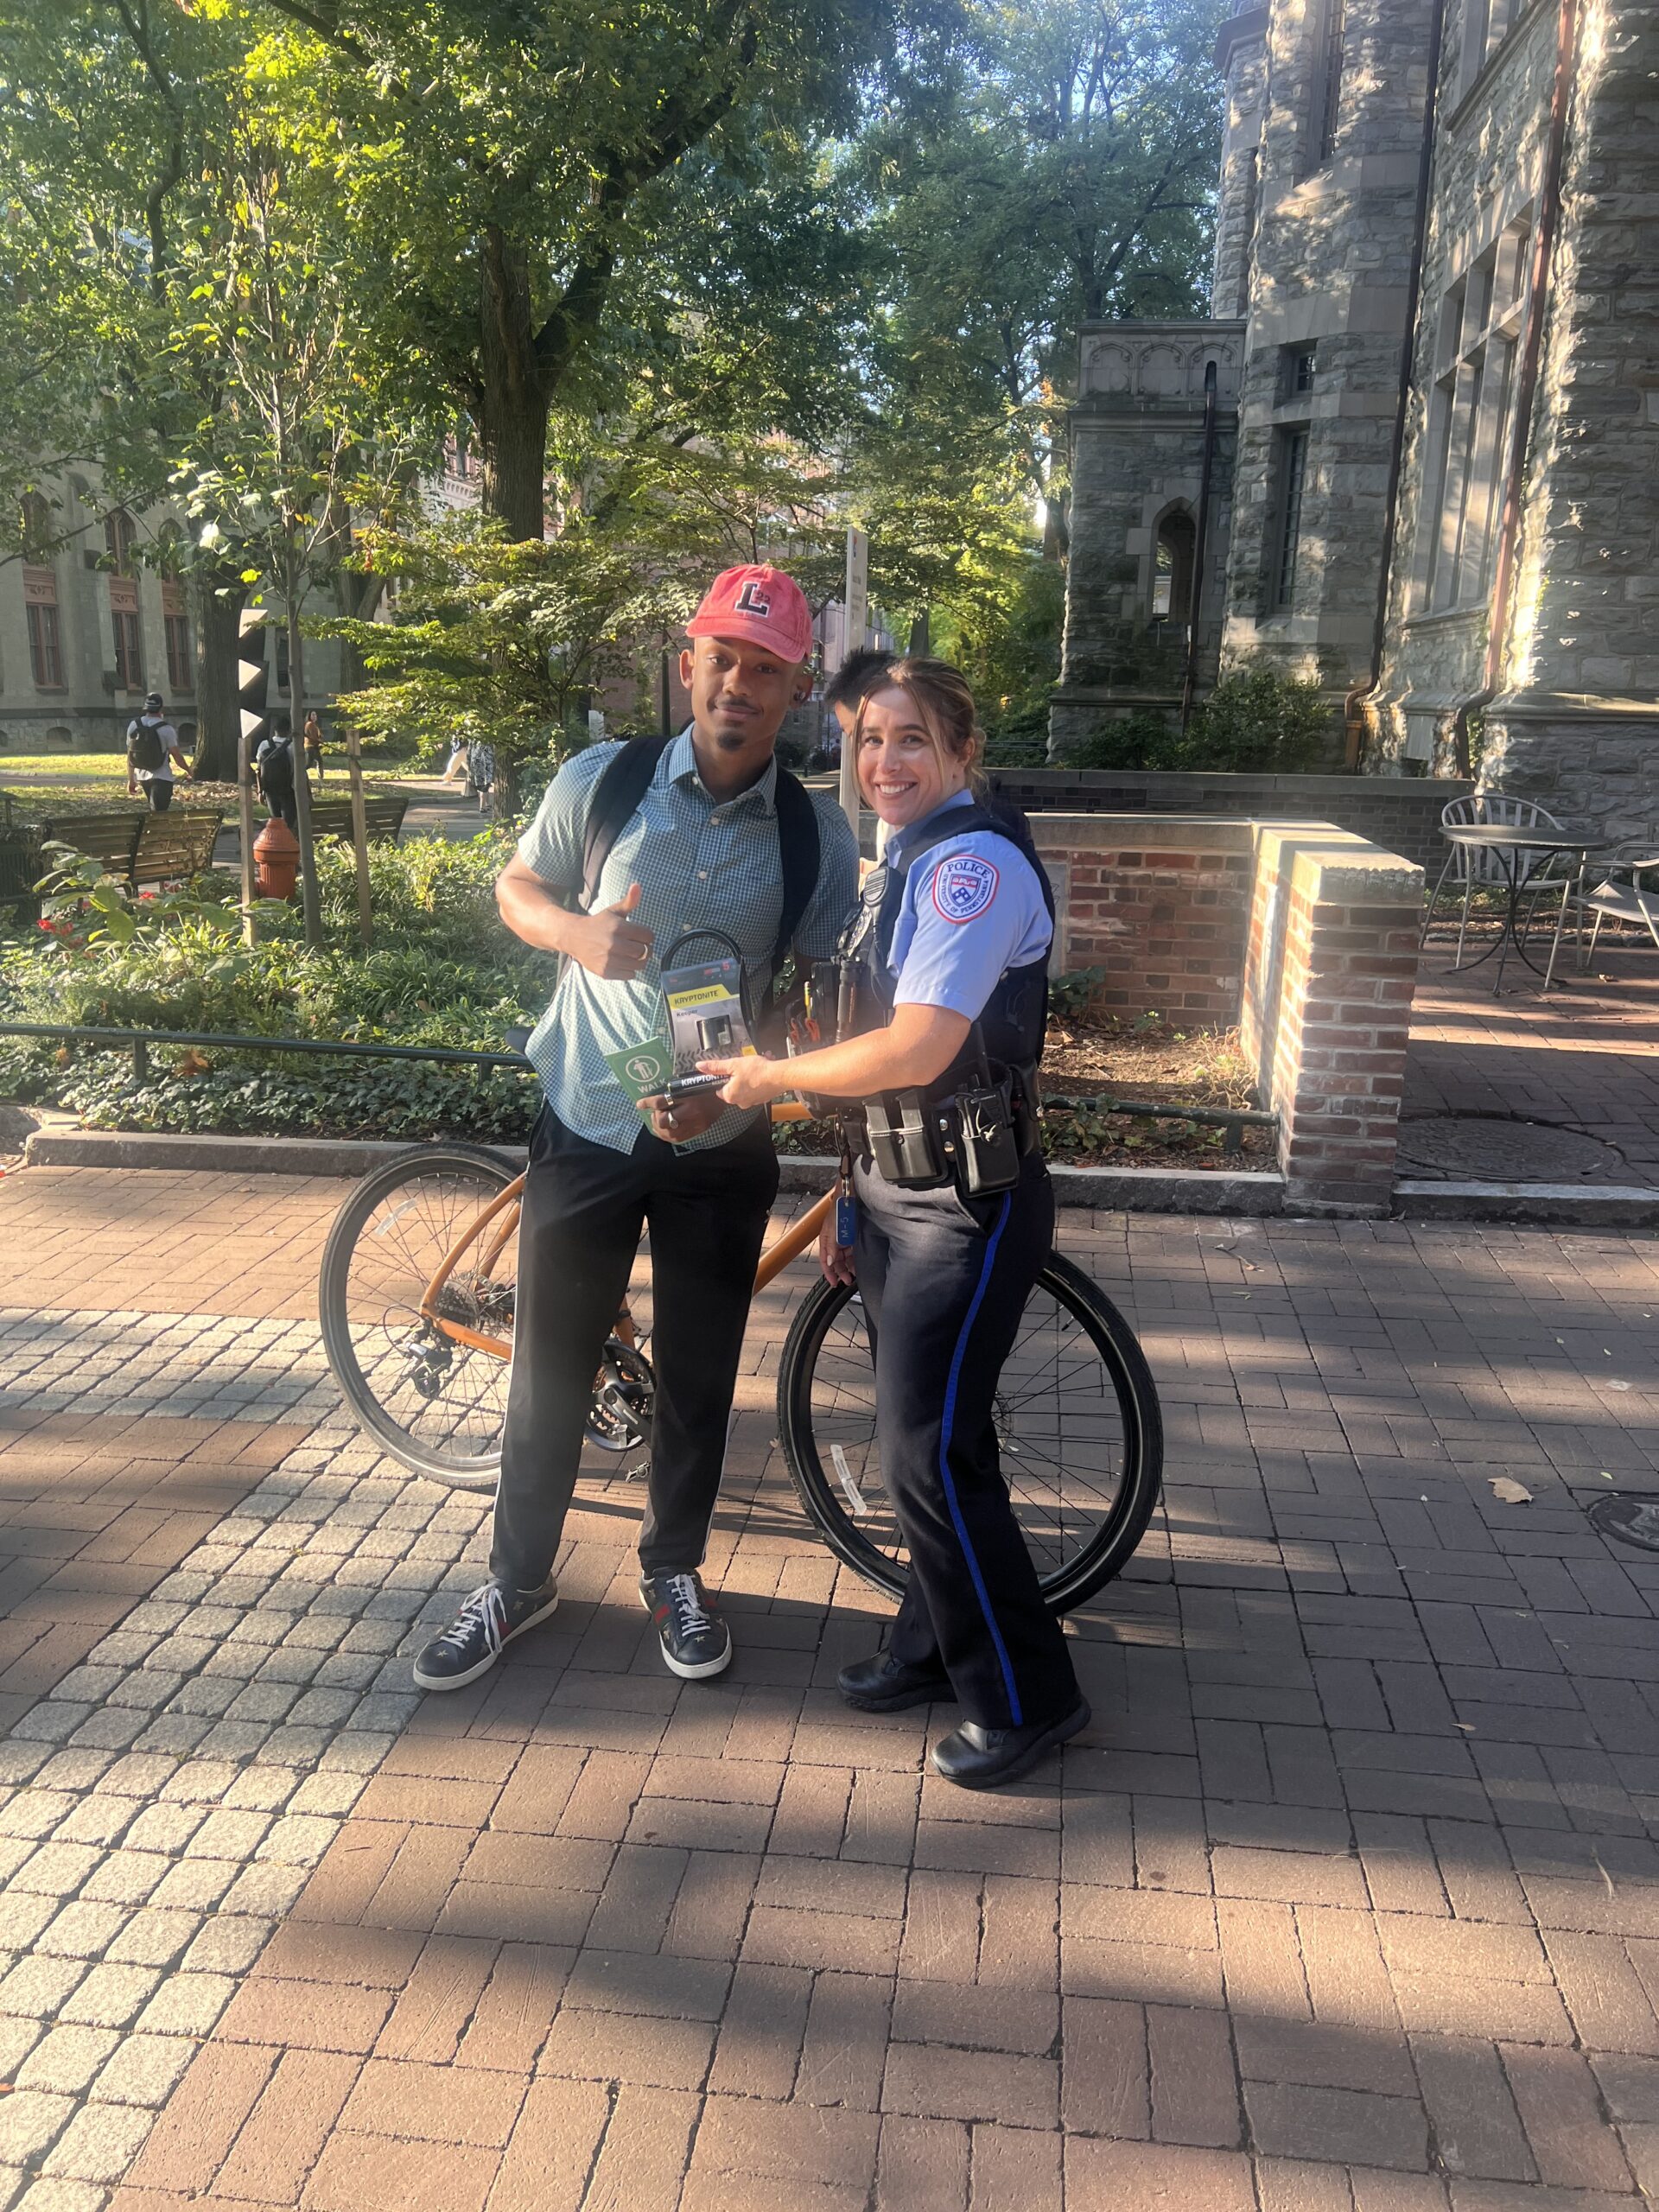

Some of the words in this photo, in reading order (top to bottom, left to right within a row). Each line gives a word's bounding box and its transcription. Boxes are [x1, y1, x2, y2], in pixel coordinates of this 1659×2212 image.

[734, 581, 769, 617] L
[756, 589, 771, 604] 22
[947, 862, 989, 878] POLICE
[941, 874, 950, 906] UNIVERSITY
[674, 989, 719, 1005] KRYPTONITE
[638, 1077, 667, 1093] WALK
[840, 1217, 849, 1238] M-5
